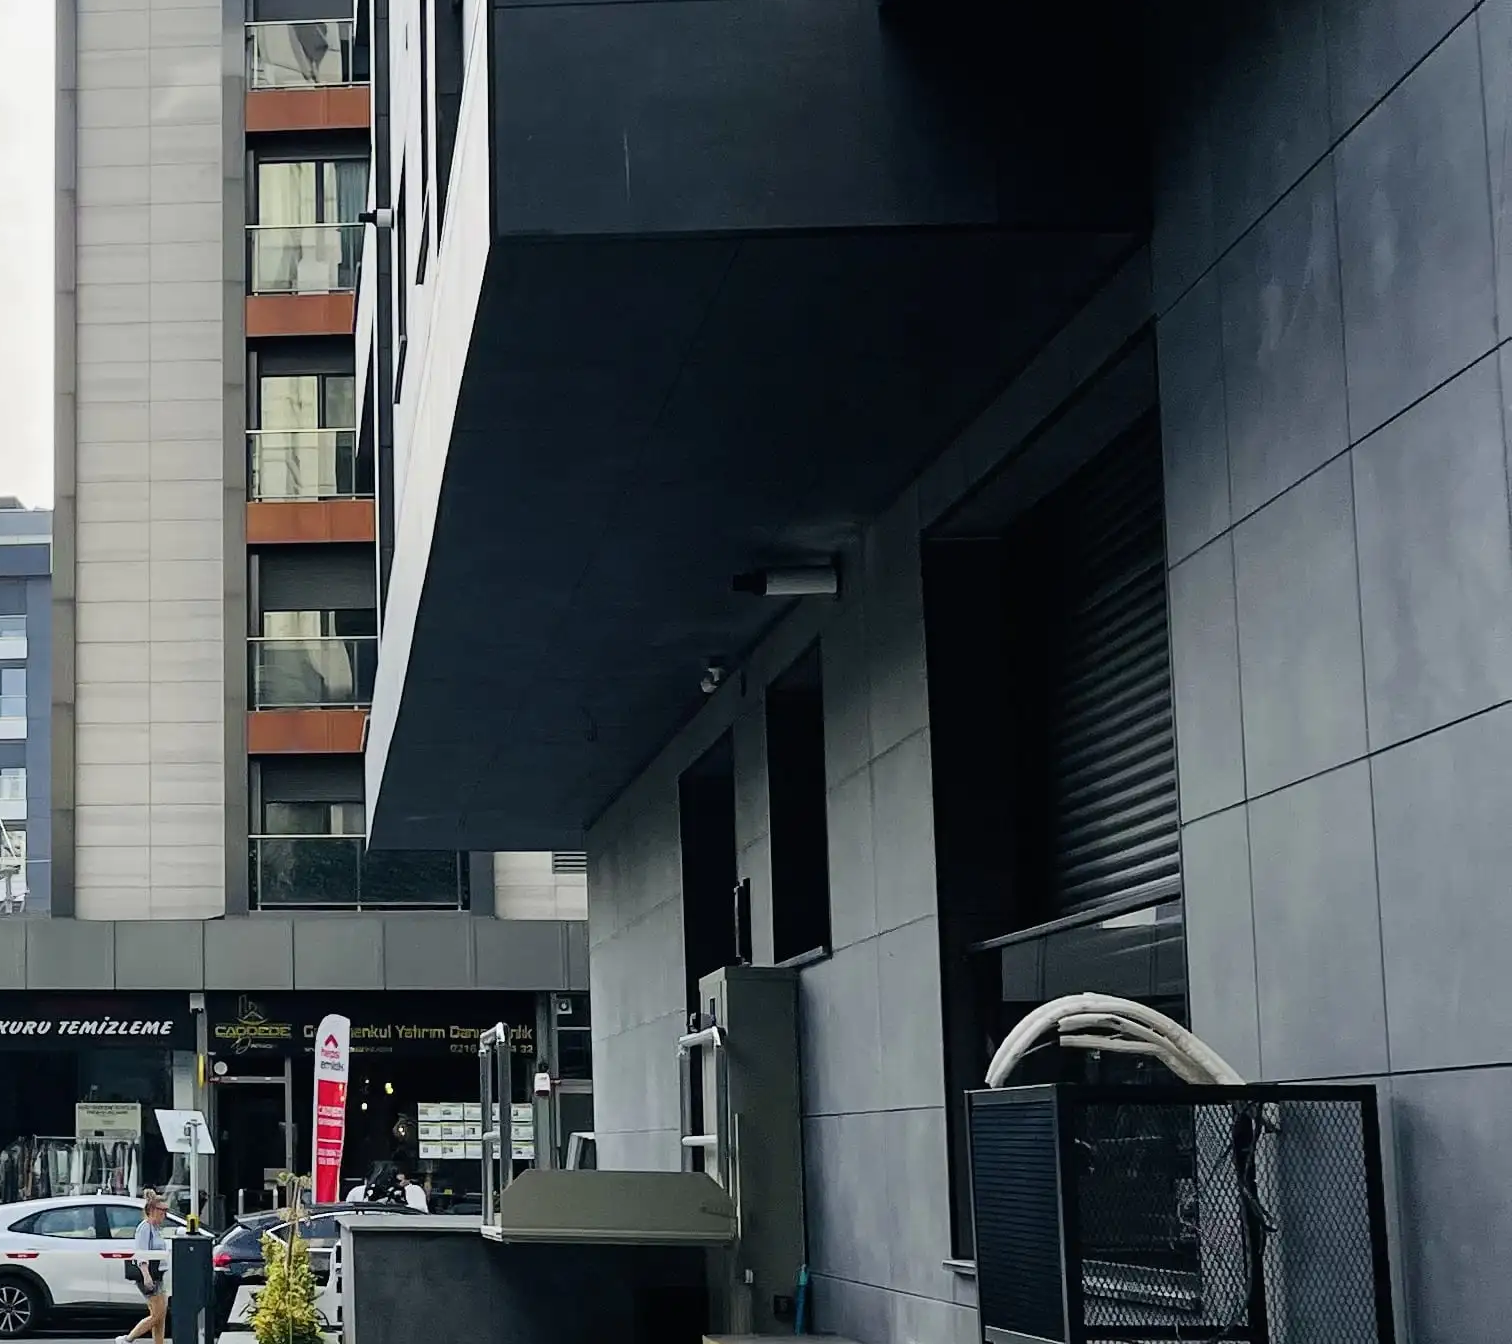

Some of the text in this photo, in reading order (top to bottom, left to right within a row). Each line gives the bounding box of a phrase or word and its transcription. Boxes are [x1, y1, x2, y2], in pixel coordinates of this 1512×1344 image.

[58, 1016, 174, 1035] TEMİZLEME
[303, 1023, 392, 1039] Genkul
[395, 1024, 446, 1039] Yatırım
